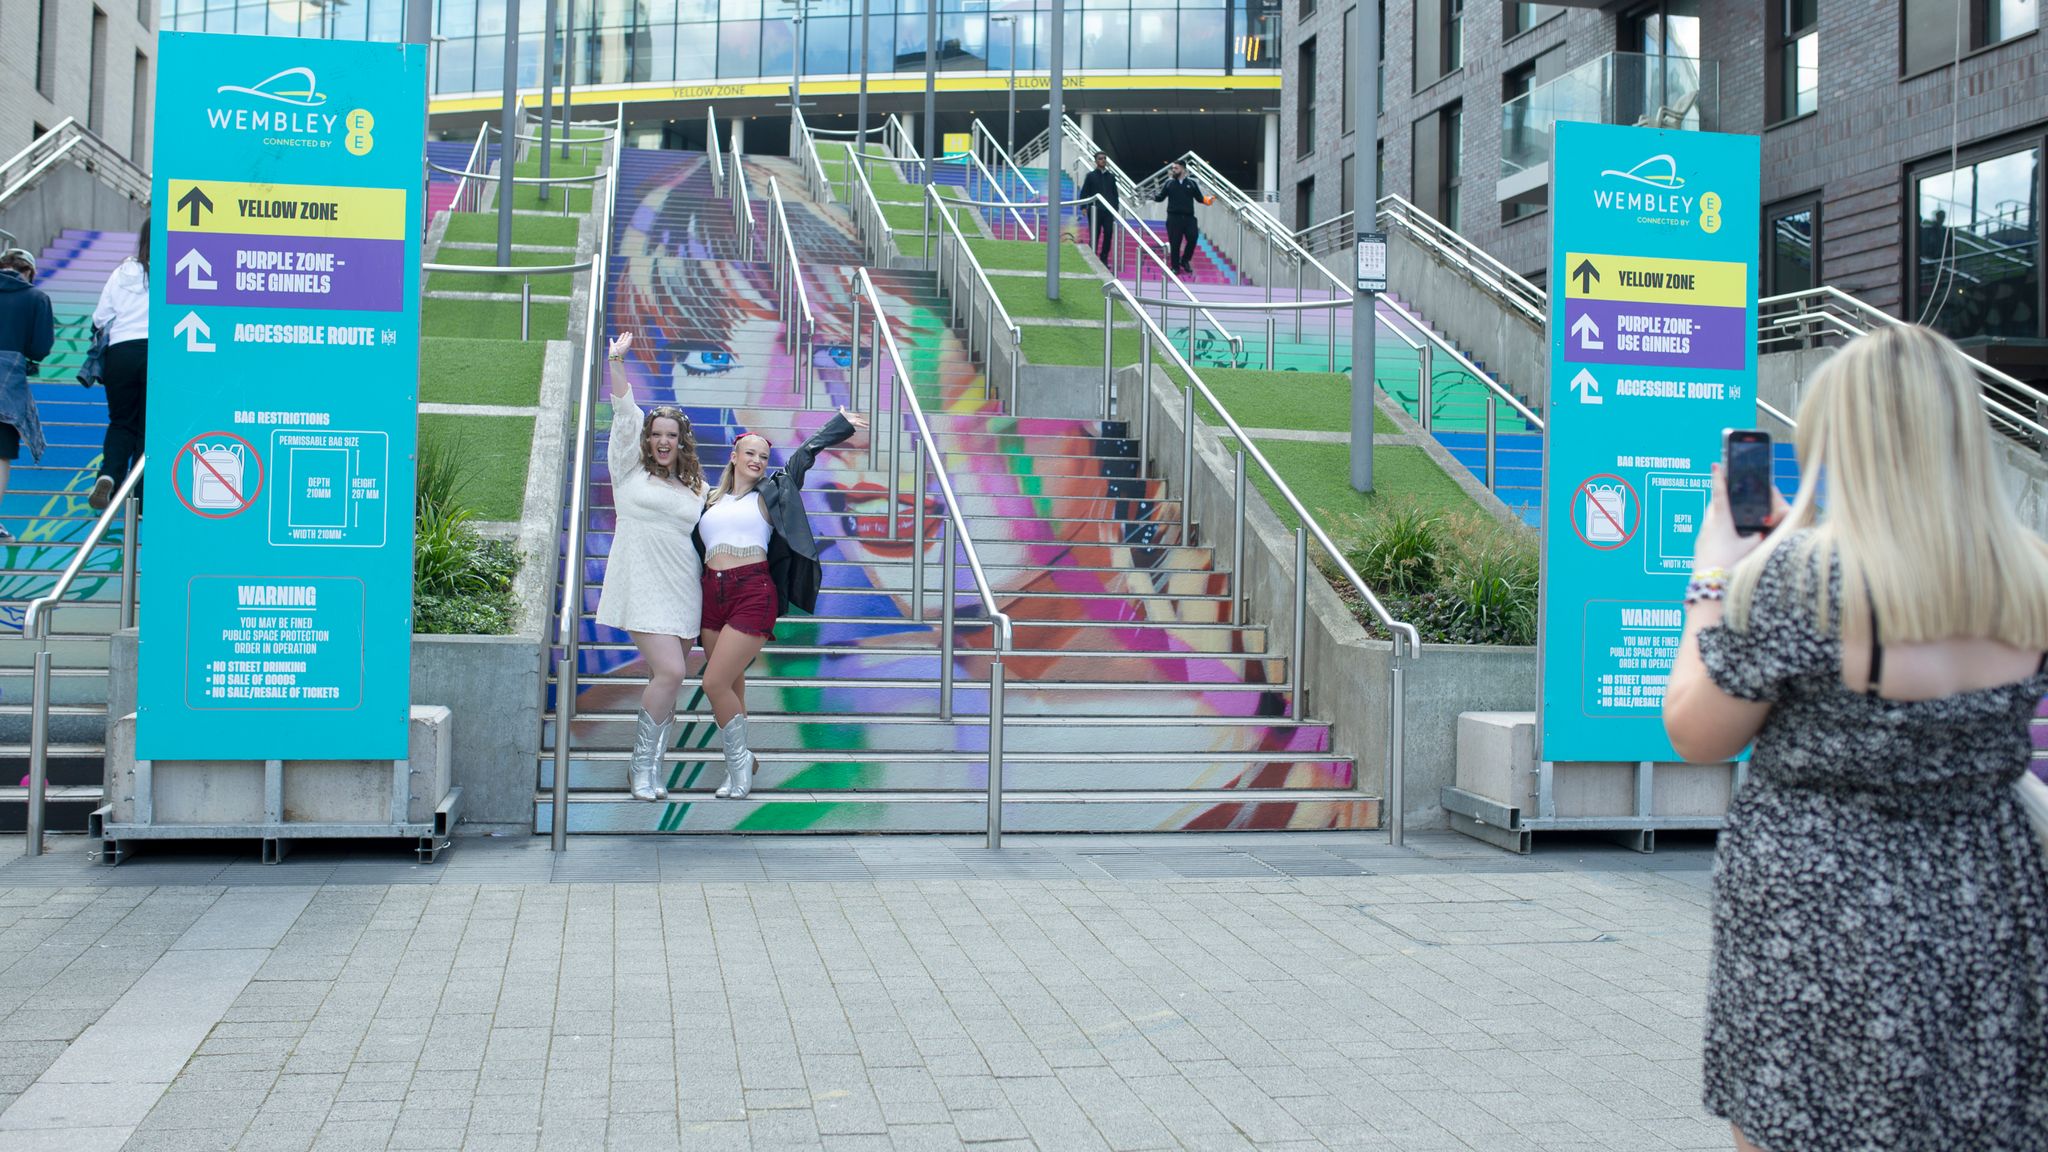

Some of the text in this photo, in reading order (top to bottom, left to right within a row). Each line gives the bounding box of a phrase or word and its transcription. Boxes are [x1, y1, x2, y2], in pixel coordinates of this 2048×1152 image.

[1062, 78, 1085, 86] ONE
[673, 85, 745, 97] YELLOW ZONE
[207, 109, 337, 133] WEMBLEY
[263, 138, 332, 148] CONNECTED BY
[1594, 190, 1693, 214] WEMBLEY
[238, 199, 338, 221] YELLOW ZONE
[1637, 217, 1679, 225] CONNECTED
[236, 251, 294, 271] PURPLE
[235, 272, 331, 294] USE GINNELS
[1619, 271, 1695, 290] YELLOW ZONE
[1617, 315, 1661, 333] PURPLE
[234, 324, 374, 346] ACCESSIBLE ROUTE
[1617, 335, 1690, 354] USE GINNELS
[1617, 379, 1724, 400] ACCESSIBLE ROUTE
[234, 411, 330, 425] BAG RESTRICTIONS
[279, 435, 359, 447] PERMISSABLE BAG SIZE
[1617, 456, 1690, 469] BAG RESTRICTIONS
[308, 477, 330, 487] DEPTH
[352, 478, 376, 488] HEIGHT
[1652, 478, 1688, 487] PERMISSABLE
[1689, 478, 1700, 488] BAG
[306, 488, 331, 499] 210MM
[352, 489, 379, 499] 297 MM
[1674, 514, 1692, 523] DEPTH
[293, 529, 342, 539] WIDTH 210MM
[1663, 559, 1680, 568] WIDTH
[237, 585, 317, 606] WARNING
[240, 617, 313, 629] YOU MAY BE FINED
[1621, 608, 1682, 627] WARNING
[222, 629, 329, 642] PUBLIC SPACE PROTECTION
[1624, 636, 1636, 646] YOU
[1637, 636, 1651, 646] MAY
[1652, 636, 1661, 646] BE
[234, 642, 317, 655] ORDER IN OPERATION
[1610, 647, 1632, 657] PUBLIC
[1633, 647, 1652, 657] SPACE
[213, 661, 307, 673] NO STREET DRINKING
[1619, 658, 1640, 668] ORDER
[1641, 658, 1648, 668] IN
[212, 674, 296, 685] NO SALE OF GOODS
[1603, 674, 1613, 684] NO
[1614, 675, 1640, 685] STREET
[212, 687, 339, 699] NO SALE/RESALE OF TICKETS
[1602, 686, 1613, 696] NO
[1614, 686, 1632, 696] SALE
[1633, 686, 1642, 696] OF
[1602, 697, 1613, 707] NO
